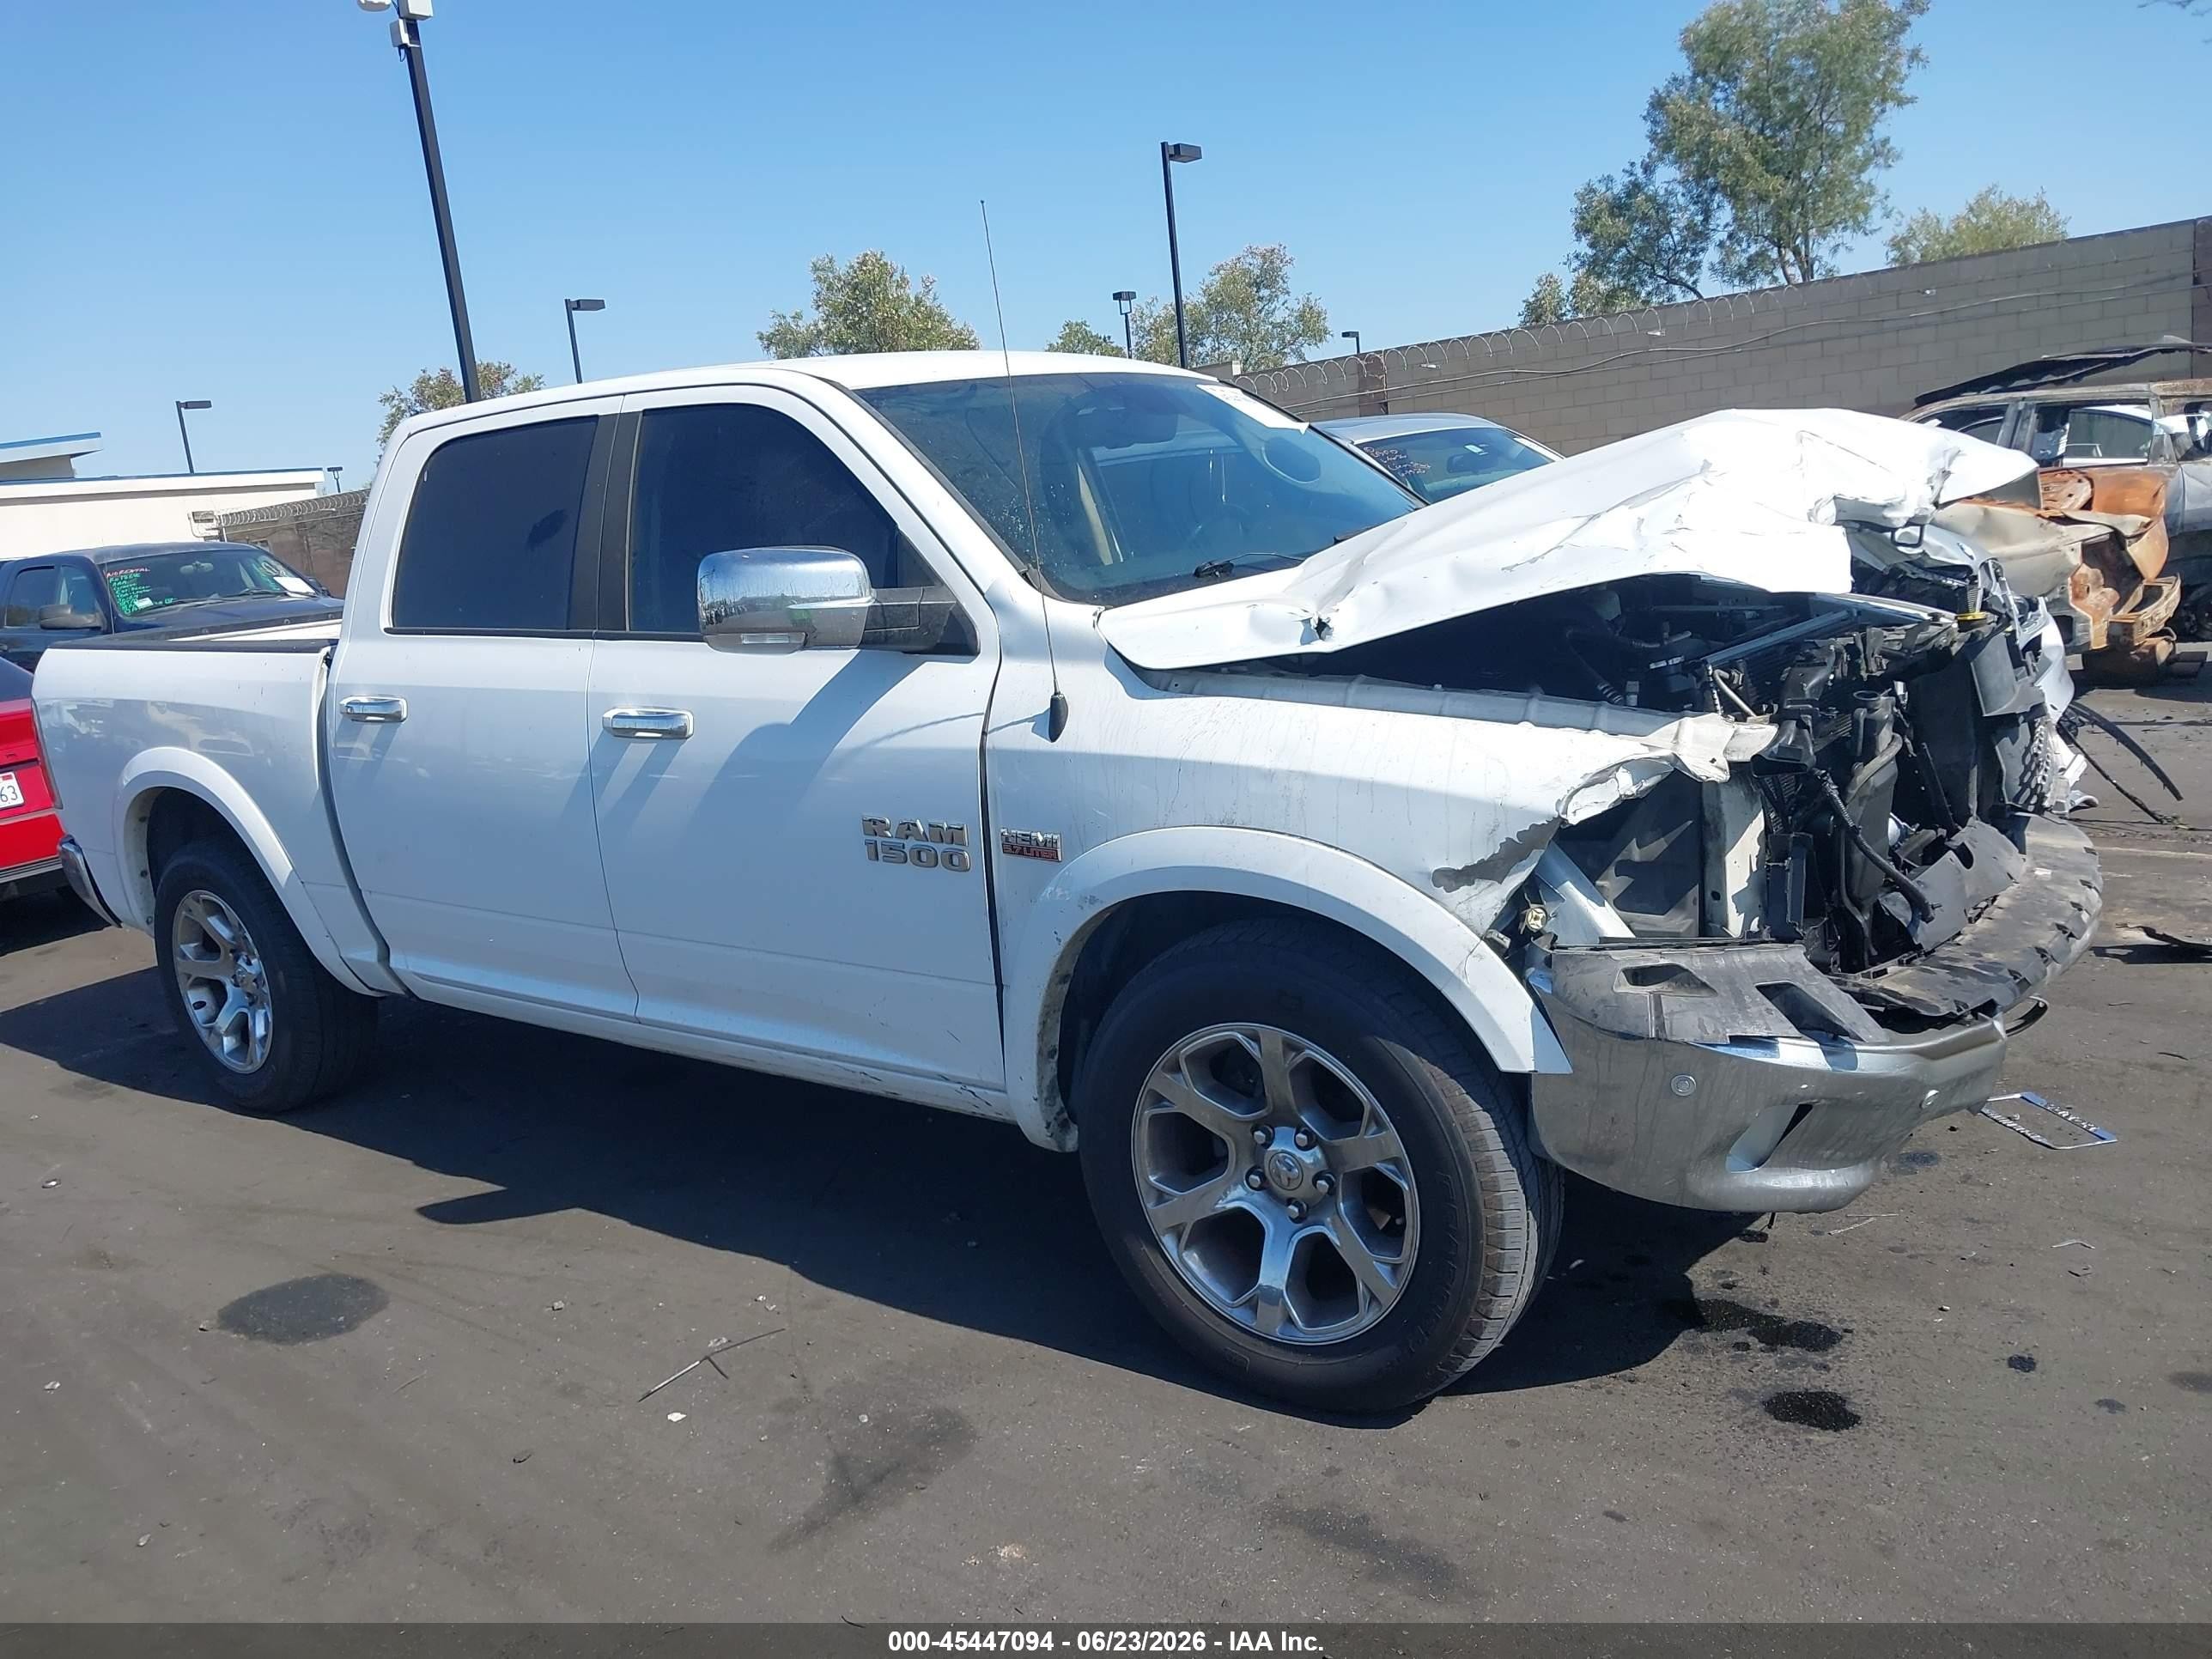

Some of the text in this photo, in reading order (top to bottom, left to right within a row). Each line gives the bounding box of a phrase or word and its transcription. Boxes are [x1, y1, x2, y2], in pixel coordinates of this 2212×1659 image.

[861, 817, 969, 847] RAM
[1000, 828, 1061, 851] HEMI
[864, 839, 970, 872] 1500
[1023, 847, 1058, 859] LITER
